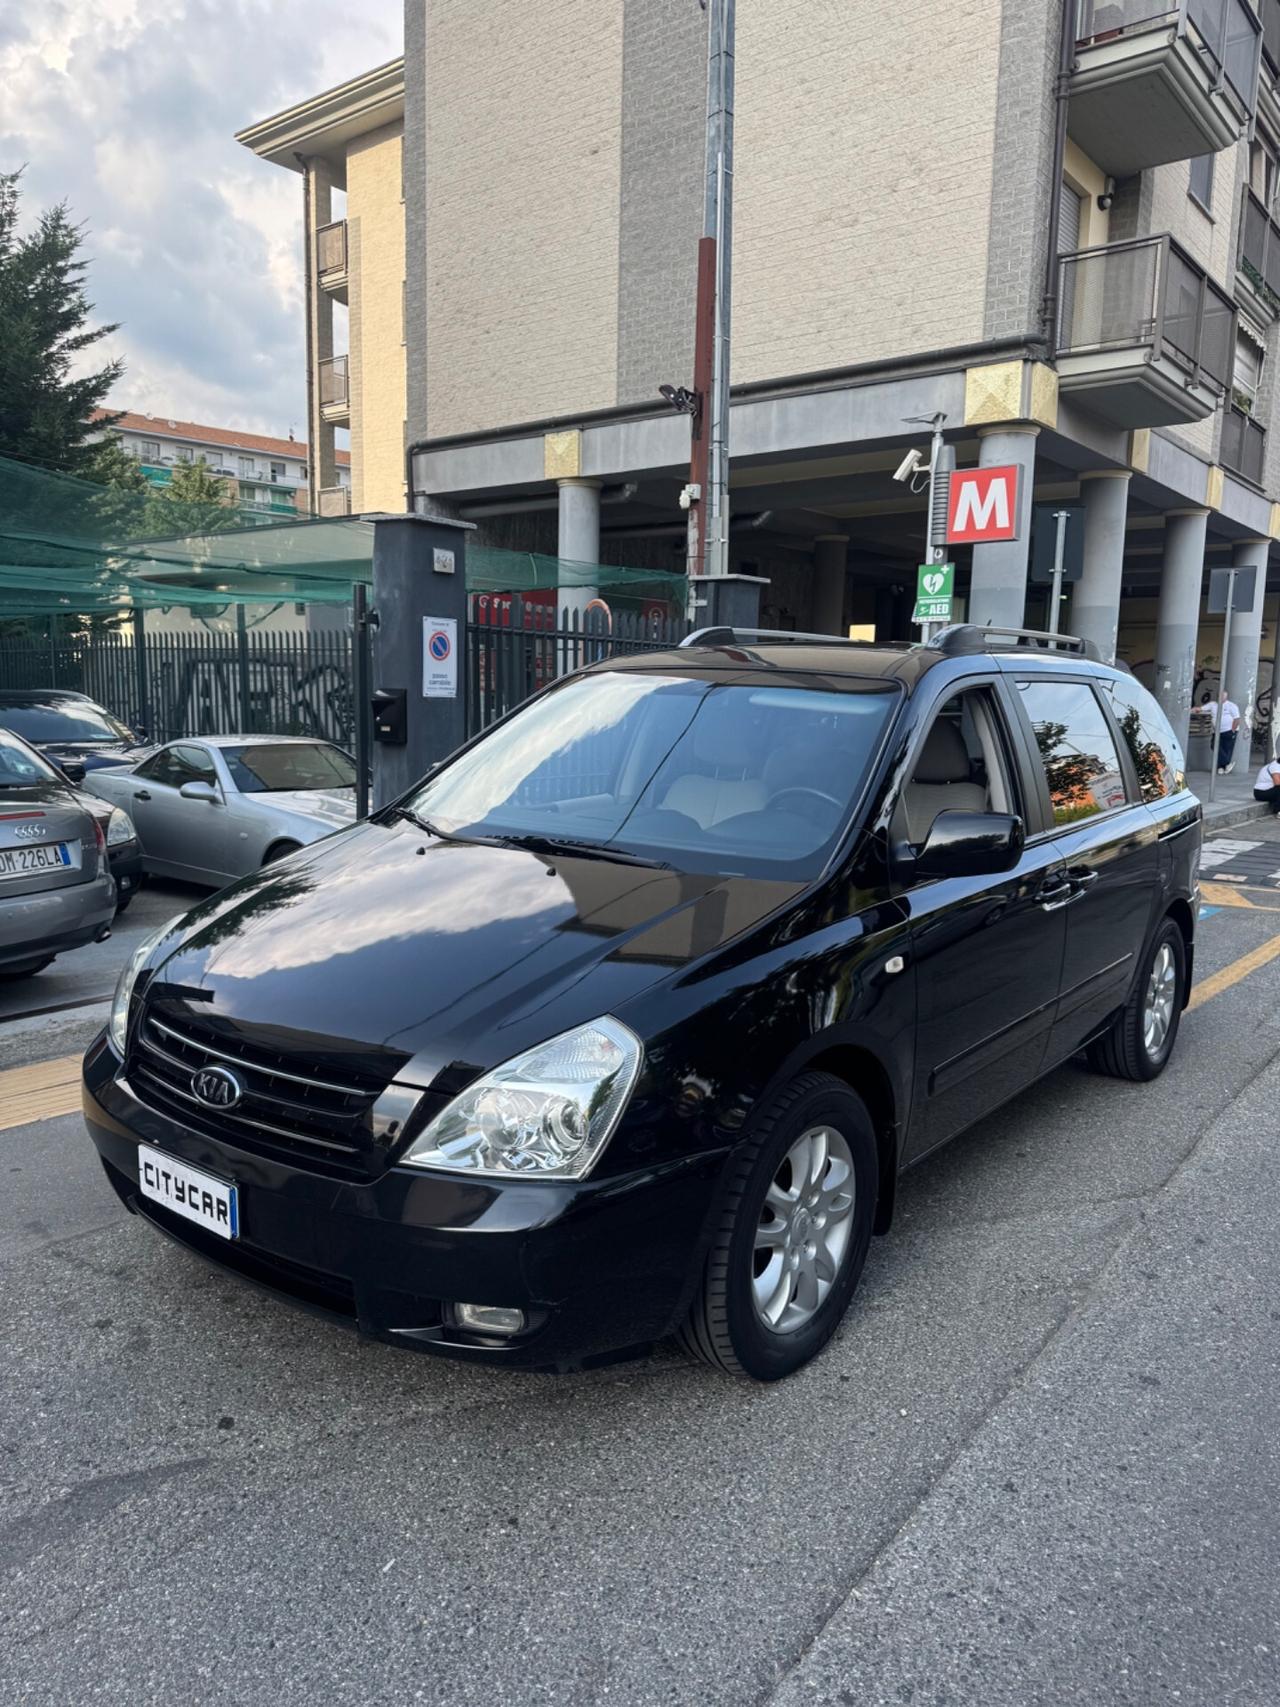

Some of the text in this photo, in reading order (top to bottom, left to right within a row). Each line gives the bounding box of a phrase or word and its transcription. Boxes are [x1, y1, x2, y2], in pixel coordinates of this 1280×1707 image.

[952, 477, 1010, 532] M
[928, 603, 949, 615] AED
[197, 1072, 229, 1104] KIA
[144, 1161, 228, 1225] CITYCAR
